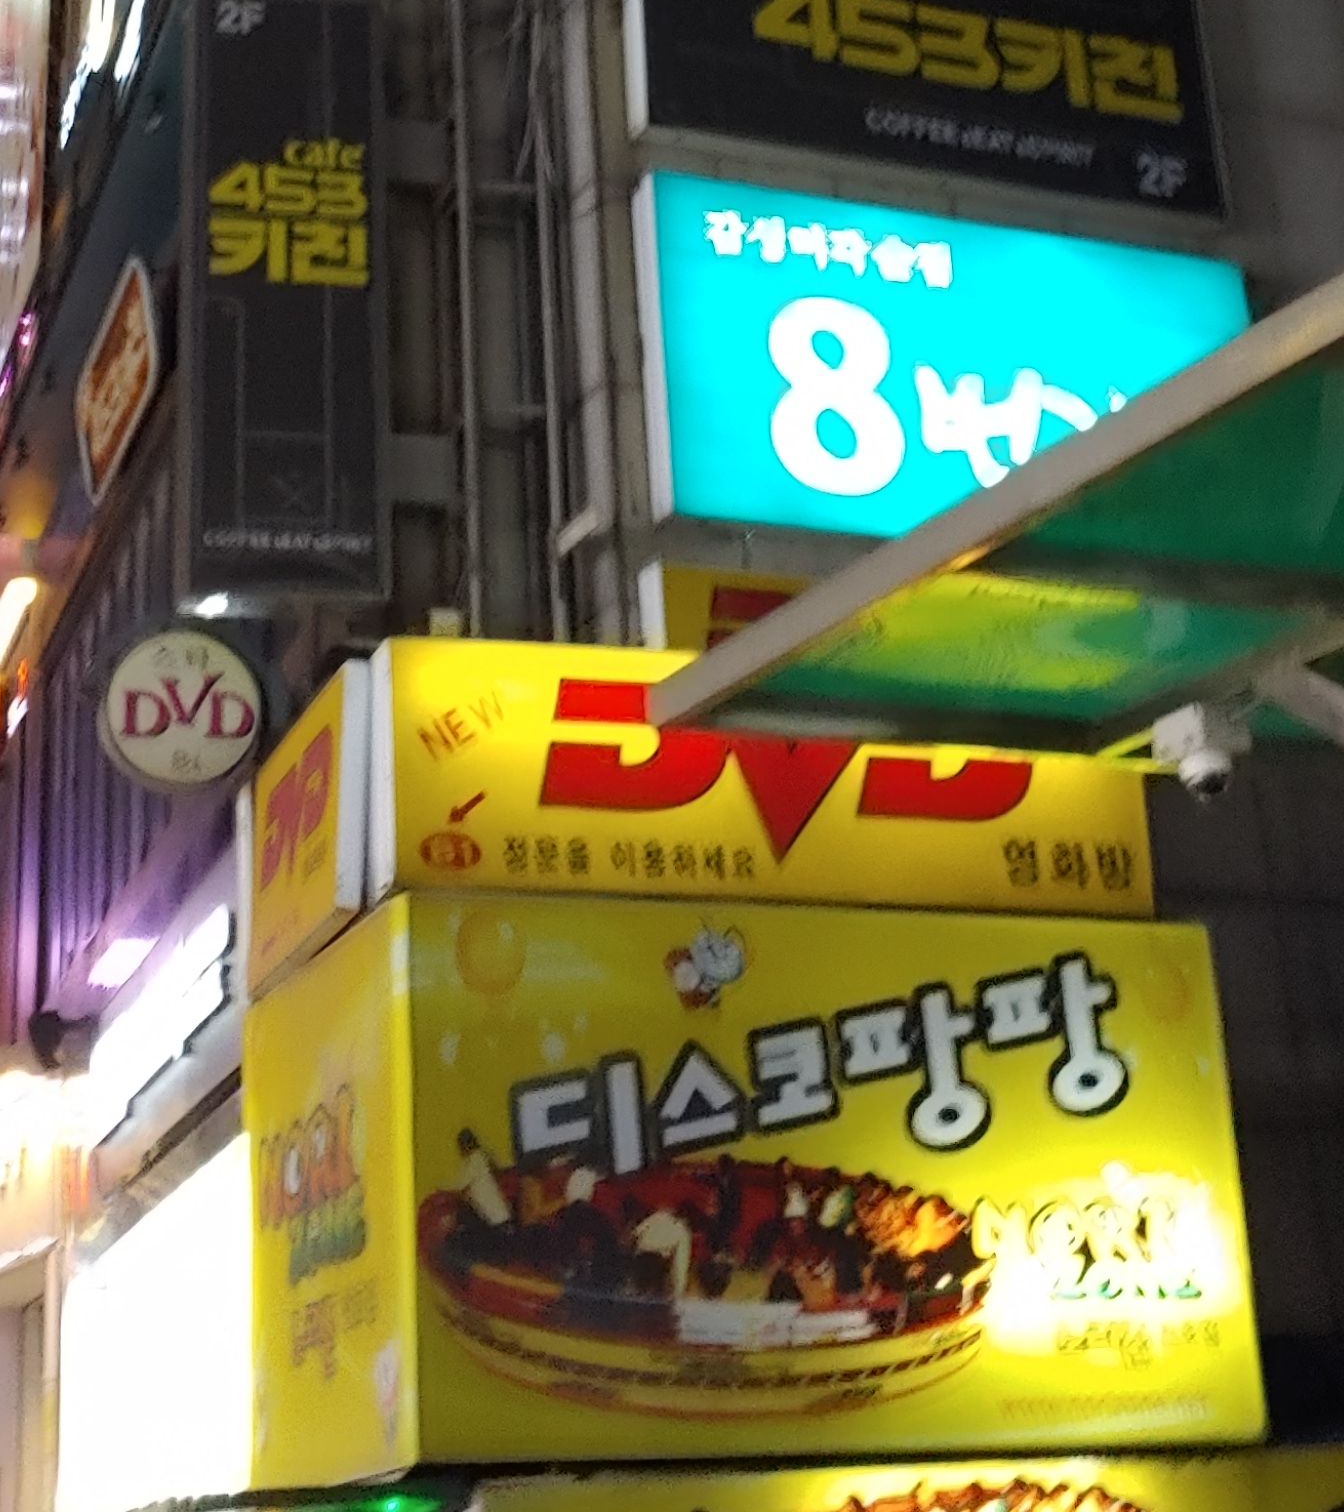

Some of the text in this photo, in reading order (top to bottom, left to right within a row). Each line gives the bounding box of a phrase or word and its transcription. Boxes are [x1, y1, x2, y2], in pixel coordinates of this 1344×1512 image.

[119, 670, 256, 740] DVD
[417, 690, 505, 763] NEW
[510, 949, 1132, 1178] 디스코팡팡
